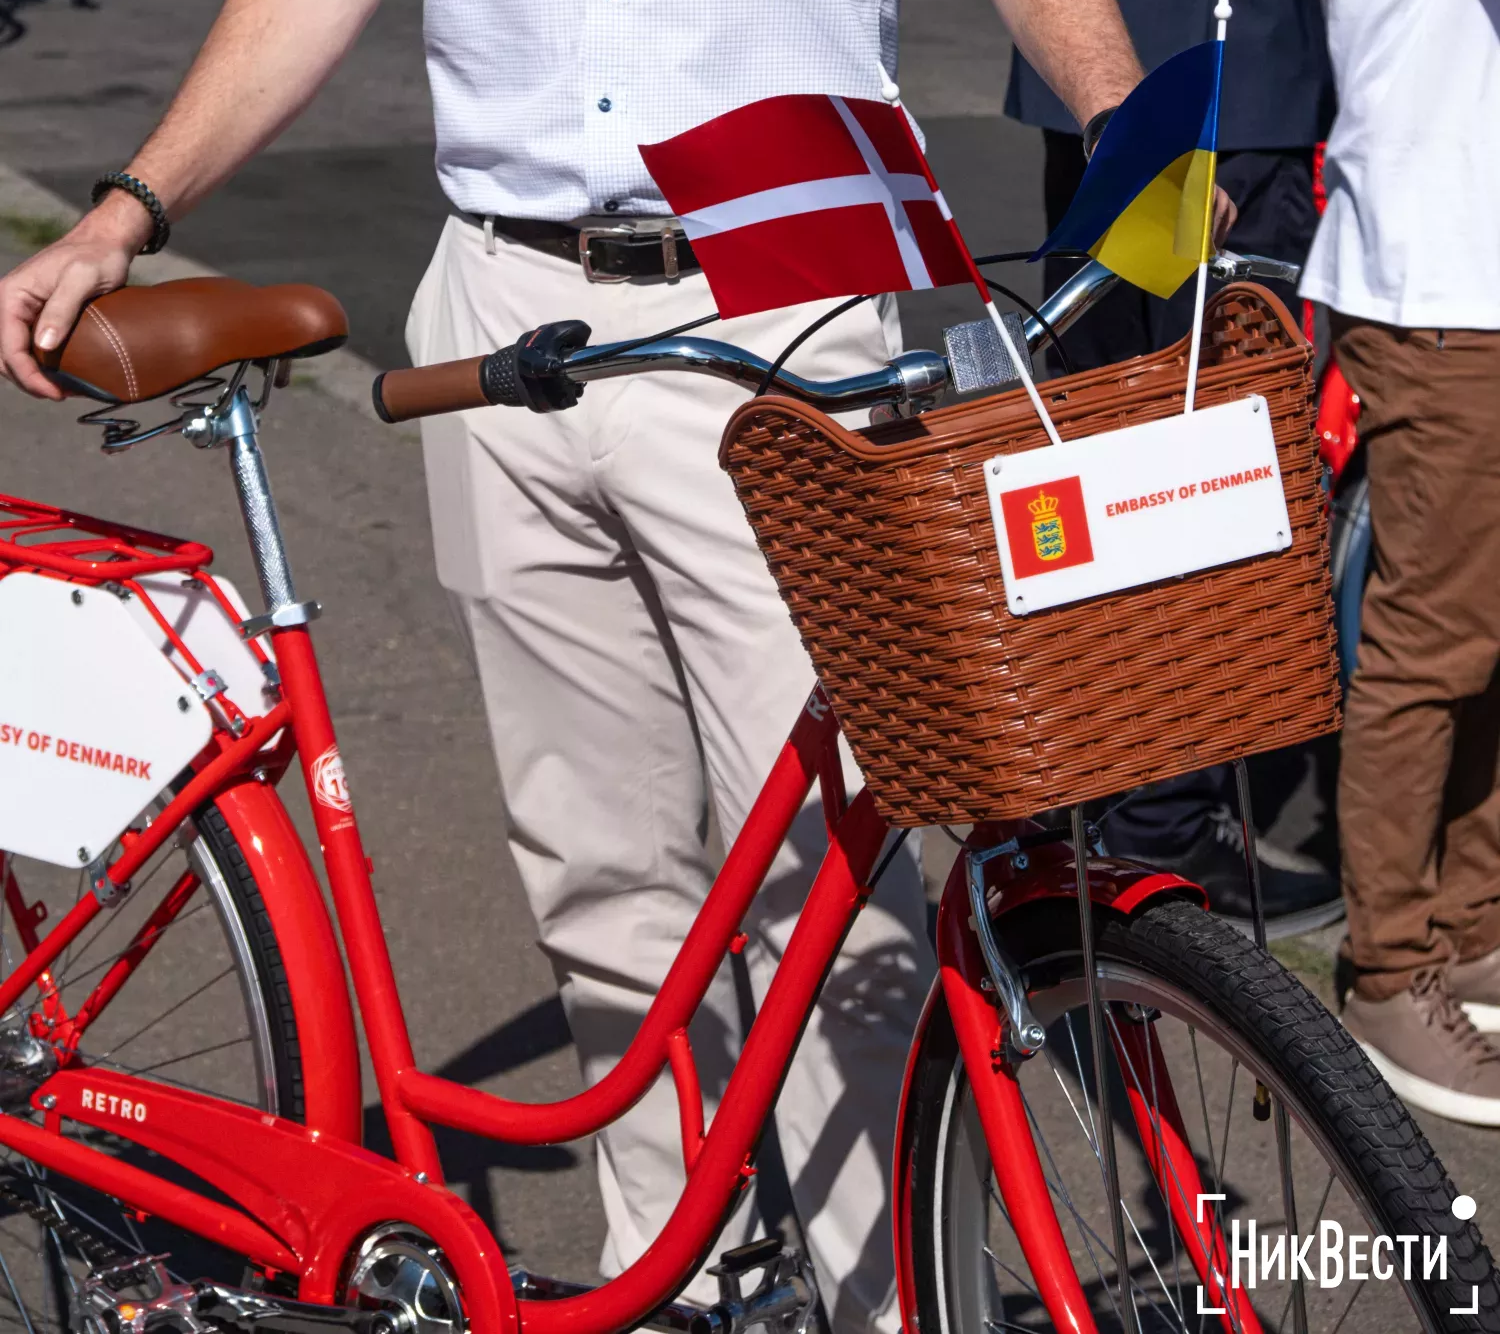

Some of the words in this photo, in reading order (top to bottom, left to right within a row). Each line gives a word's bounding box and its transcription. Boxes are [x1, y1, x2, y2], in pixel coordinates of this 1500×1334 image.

[1105, 489, 1175, 518] EMBASSY
[1178, 482, 1197, 500] OF
[1200, 465, 1274, 495] DENMARK
[27, 731, 51, 753] OF
[55, 737, 151, 781] DENMARK
[81, 1088, 147, 1122] RETRO
